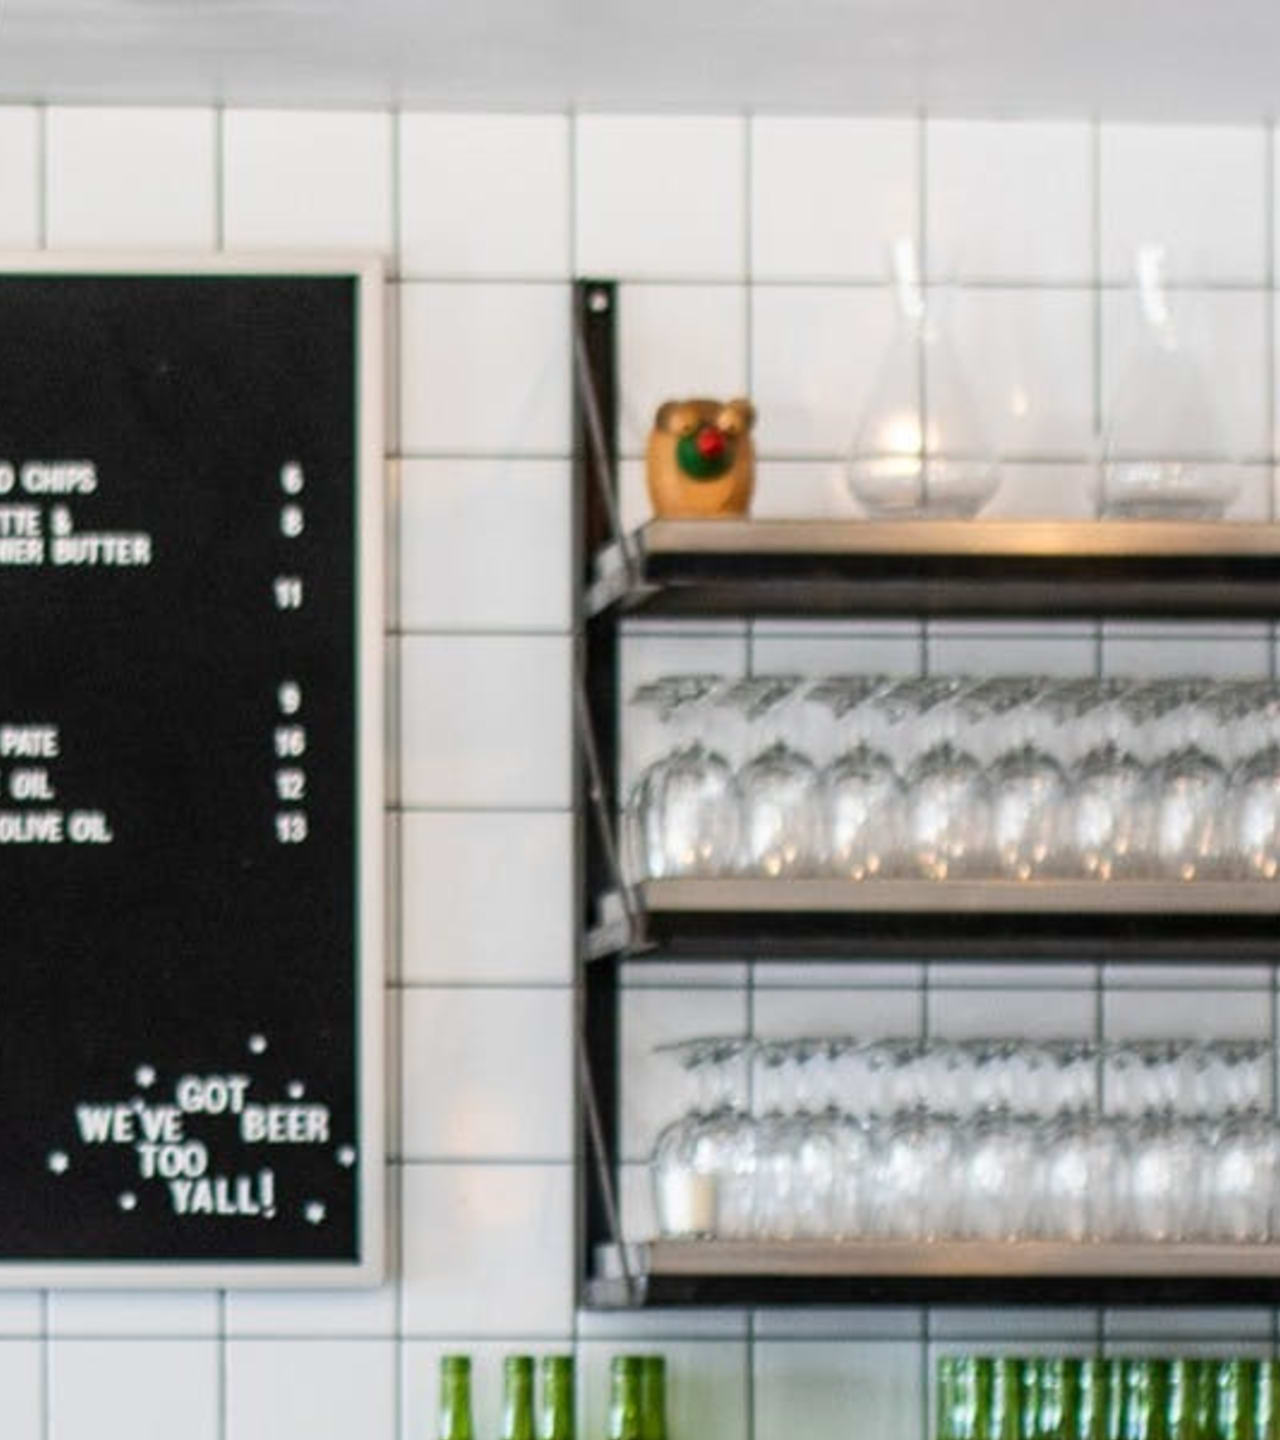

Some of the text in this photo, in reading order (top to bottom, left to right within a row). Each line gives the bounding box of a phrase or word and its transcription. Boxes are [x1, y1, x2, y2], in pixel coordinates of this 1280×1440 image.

[20, 460, 97, 494] CHIPS
[50, 535, 151, 565] BUTTER
[10, 768, 54, 800] OIL
[68, 810, 112, 843] OIL
[76, 1074, 330, 1143] WE'VE GOT BEER
[137, 1143, 208, 1179] TOO
[169, 1170, 276, 1218] YALL!
